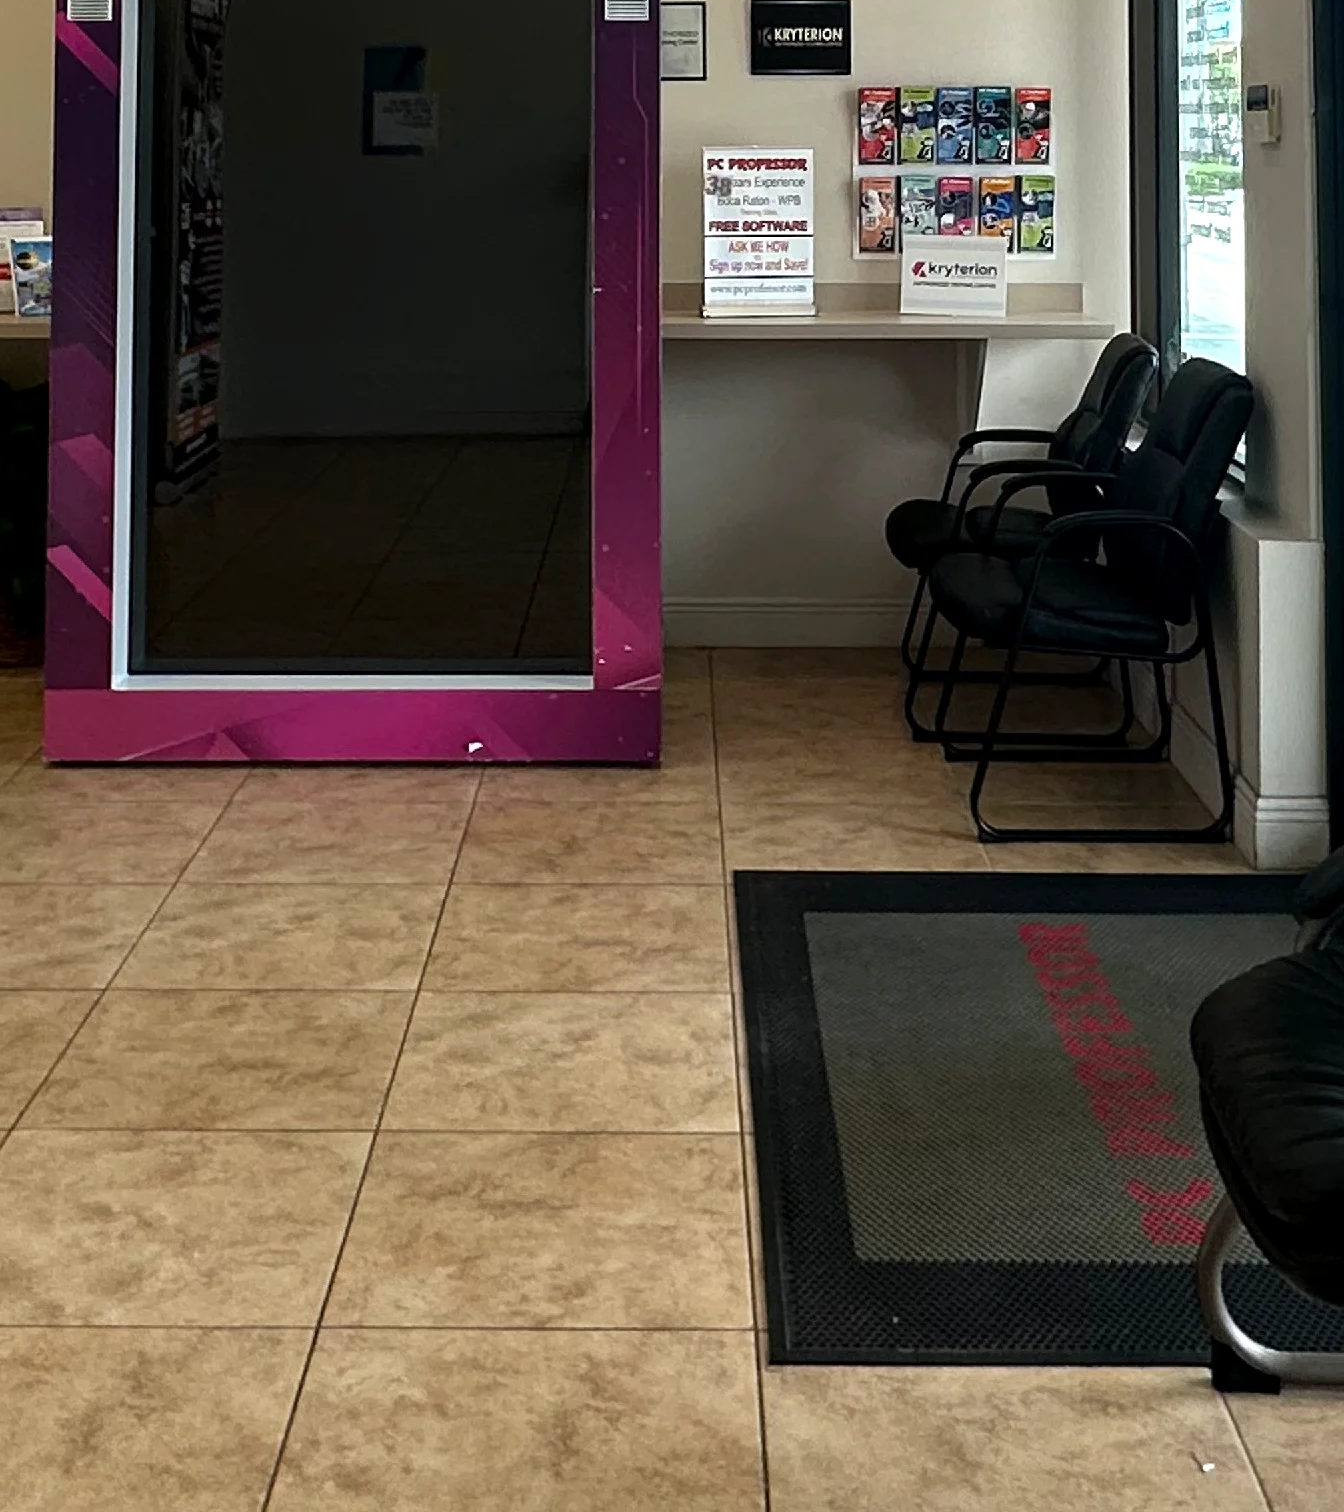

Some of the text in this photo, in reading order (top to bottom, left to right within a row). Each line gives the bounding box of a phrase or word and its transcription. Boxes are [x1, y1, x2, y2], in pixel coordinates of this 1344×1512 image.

[774, 27, 843, 41] KRYTERION
[707, 159, 807, 171] PC PROFESSOR
[755, 177, 805, 188] Experience
[709, 221, 808, 232] FREE SOFTWARE
[729, 241, 789, 253] ASK ME HOW
[709, 259, 729, 274] Sign
[929, 262, 997, 277] kryterion
[1016, 922, 1196, 1161] PROFESSOR
